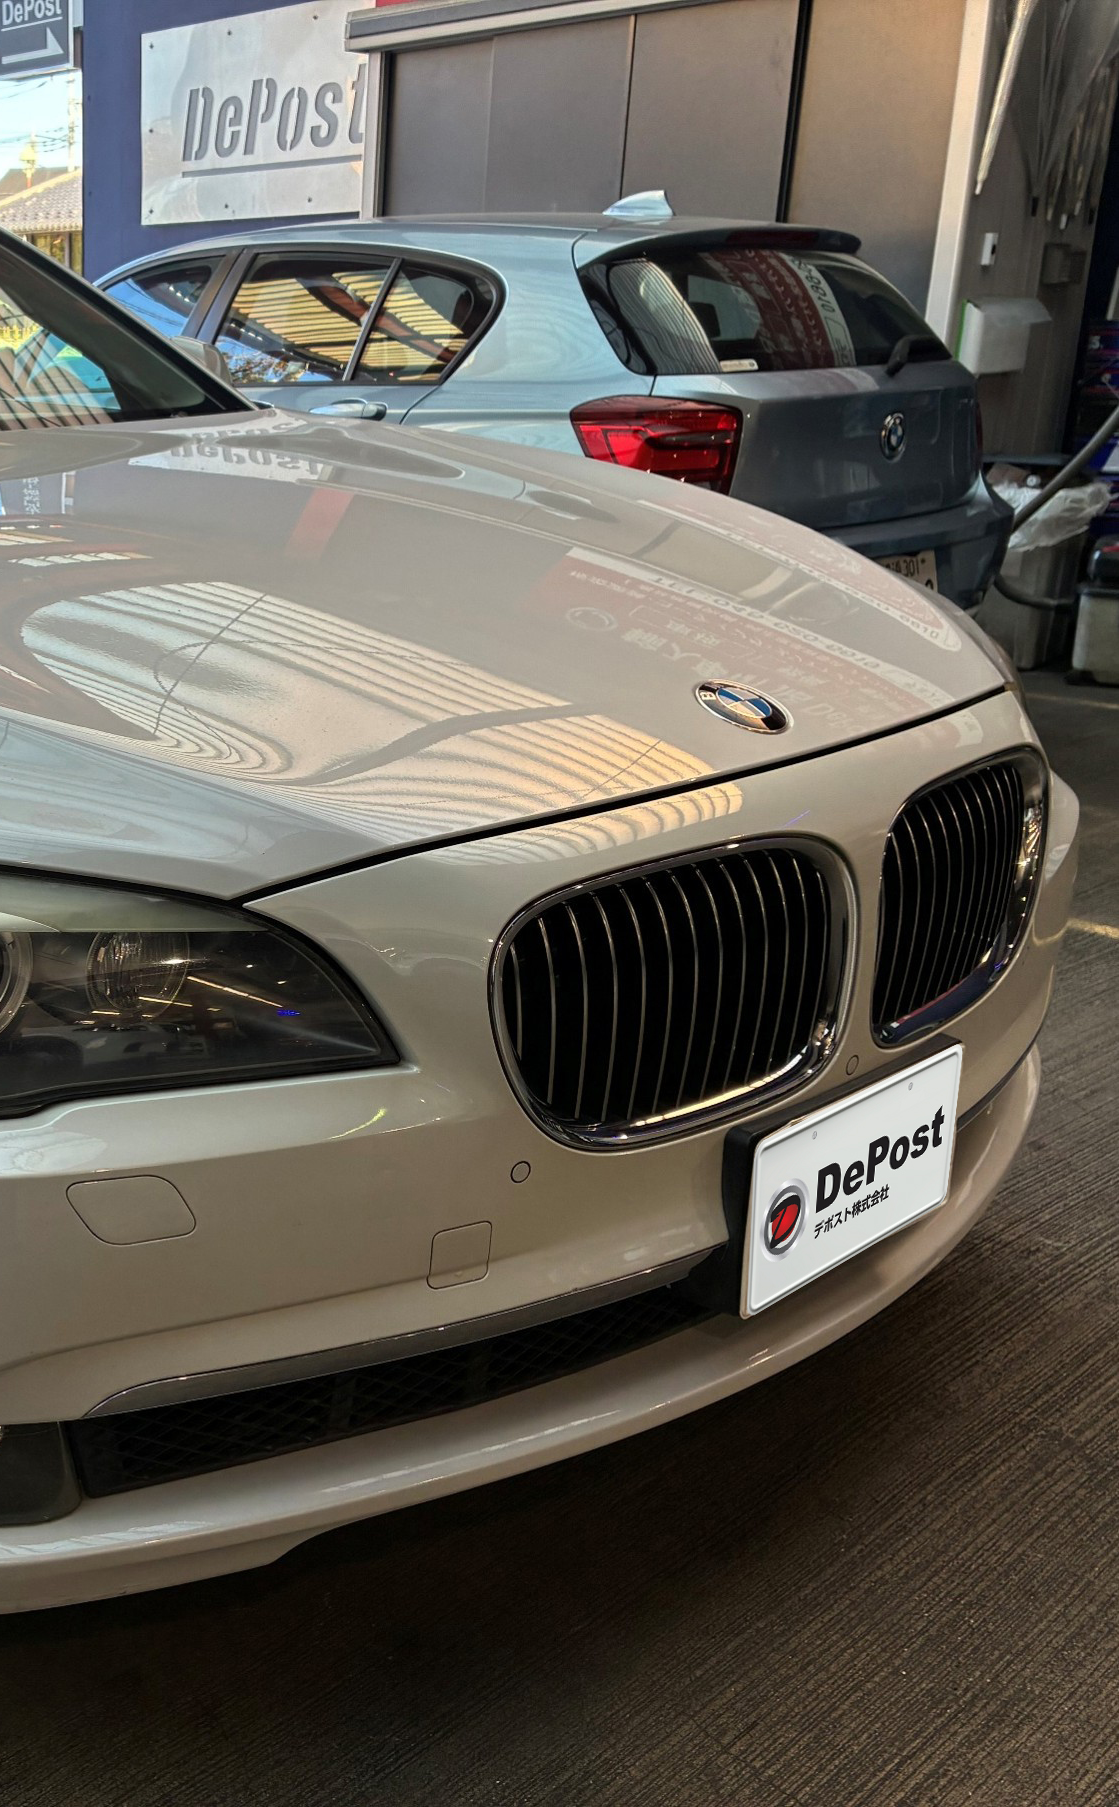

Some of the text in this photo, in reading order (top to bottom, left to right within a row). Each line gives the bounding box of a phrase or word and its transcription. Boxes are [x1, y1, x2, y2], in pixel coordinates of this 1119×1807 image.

[2, 0, 62, 25] DePost
[183, 63, 367, 162] DePost
[815, 1104, 945, 1213] DePost
[813, 1183, 890, 1240] デポスト株式会社
